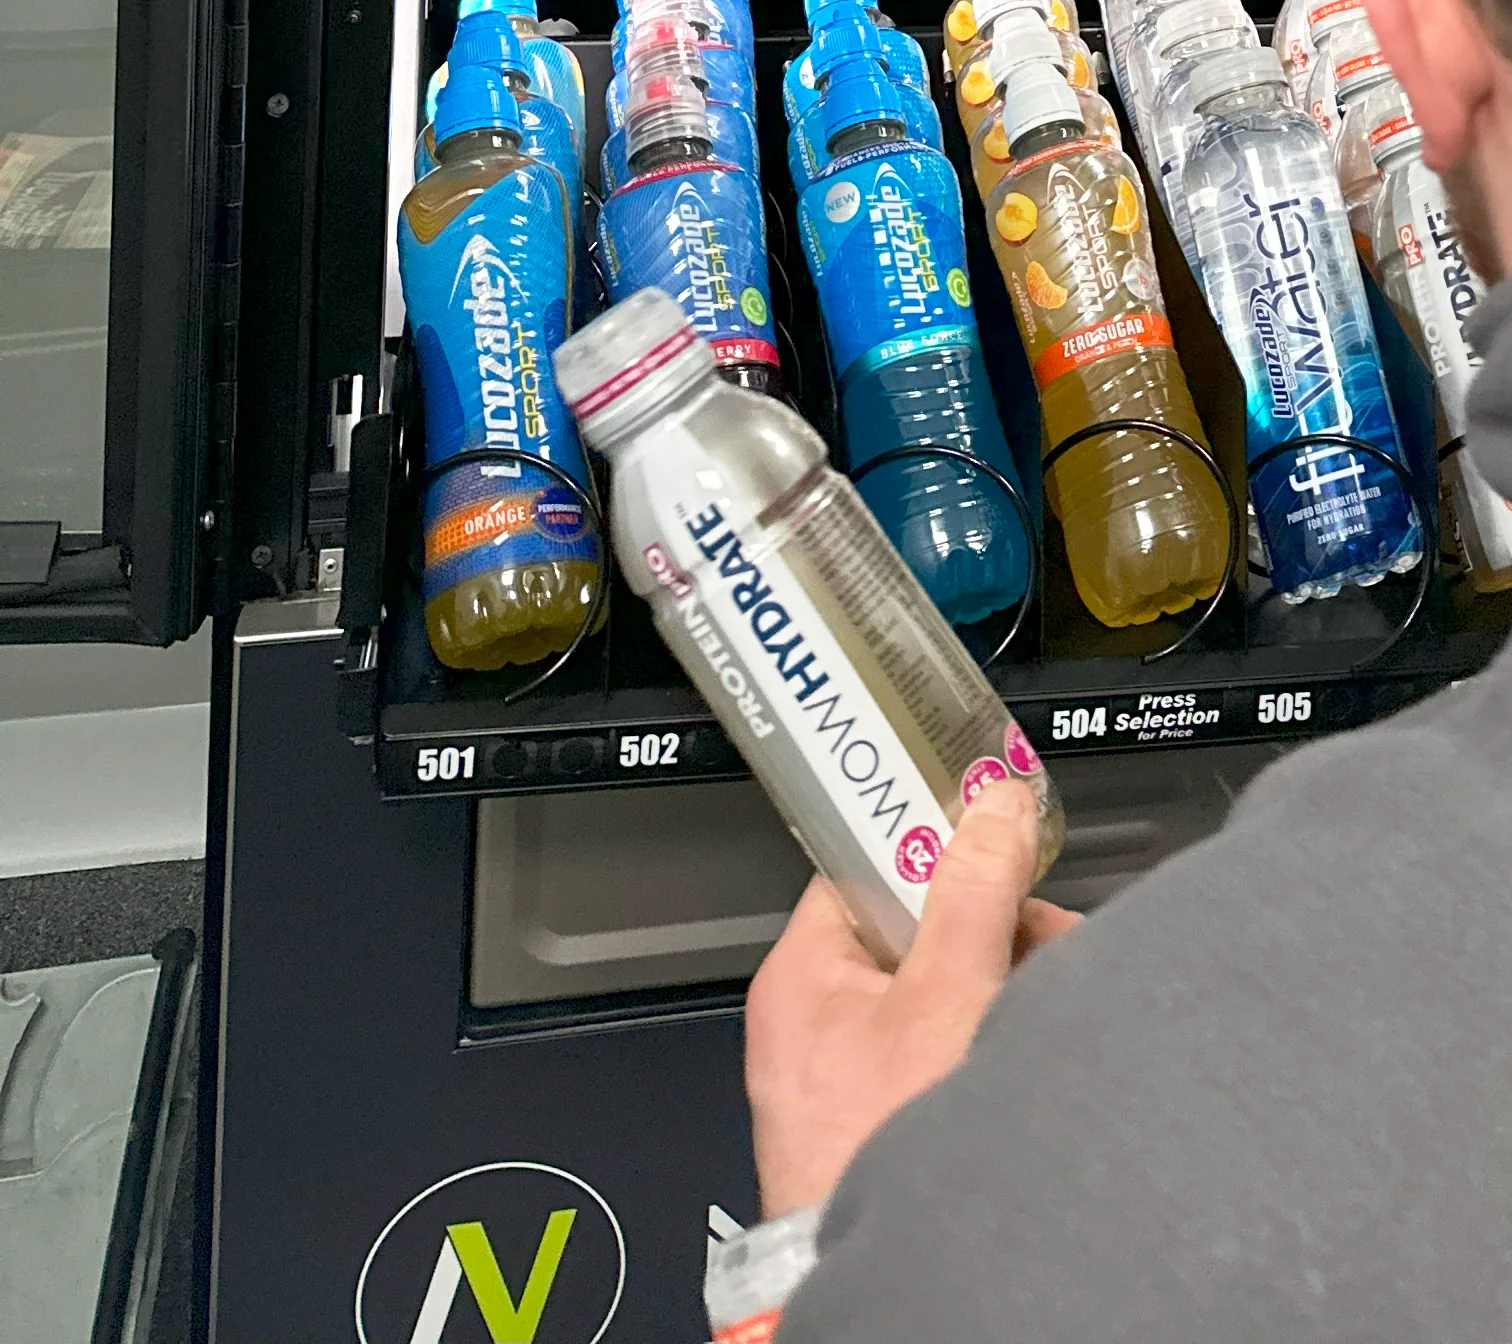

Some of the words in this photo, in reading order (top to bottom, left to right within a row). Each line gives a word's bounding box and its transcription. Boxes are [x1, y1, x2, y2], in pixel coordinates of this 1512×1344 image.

[826, 192, 856, 213] NEW
[1061, 330, 1098, 359] ZERO
[1097, 317, 1145, 343] SUGAR
[1278, 332, 1297, 390] SPORT
[515, 325, 540, 439] SPORT
[463, 503, 527, 536] ORANGE
[675, 596, 774, 739] PROTEIN
[1138, 693, 1197, 711] Press
[1257, 691, 1311, 723] 505
[1052, 707, 1107, 740] 504
[1113, 708, 1220, 732] Selection
[1137, 730, 1157, 741] for
[1159, 727, 1194, 739] Price
[417, 746, 476, 782] 501
[618, 732, 680, 766] 502
